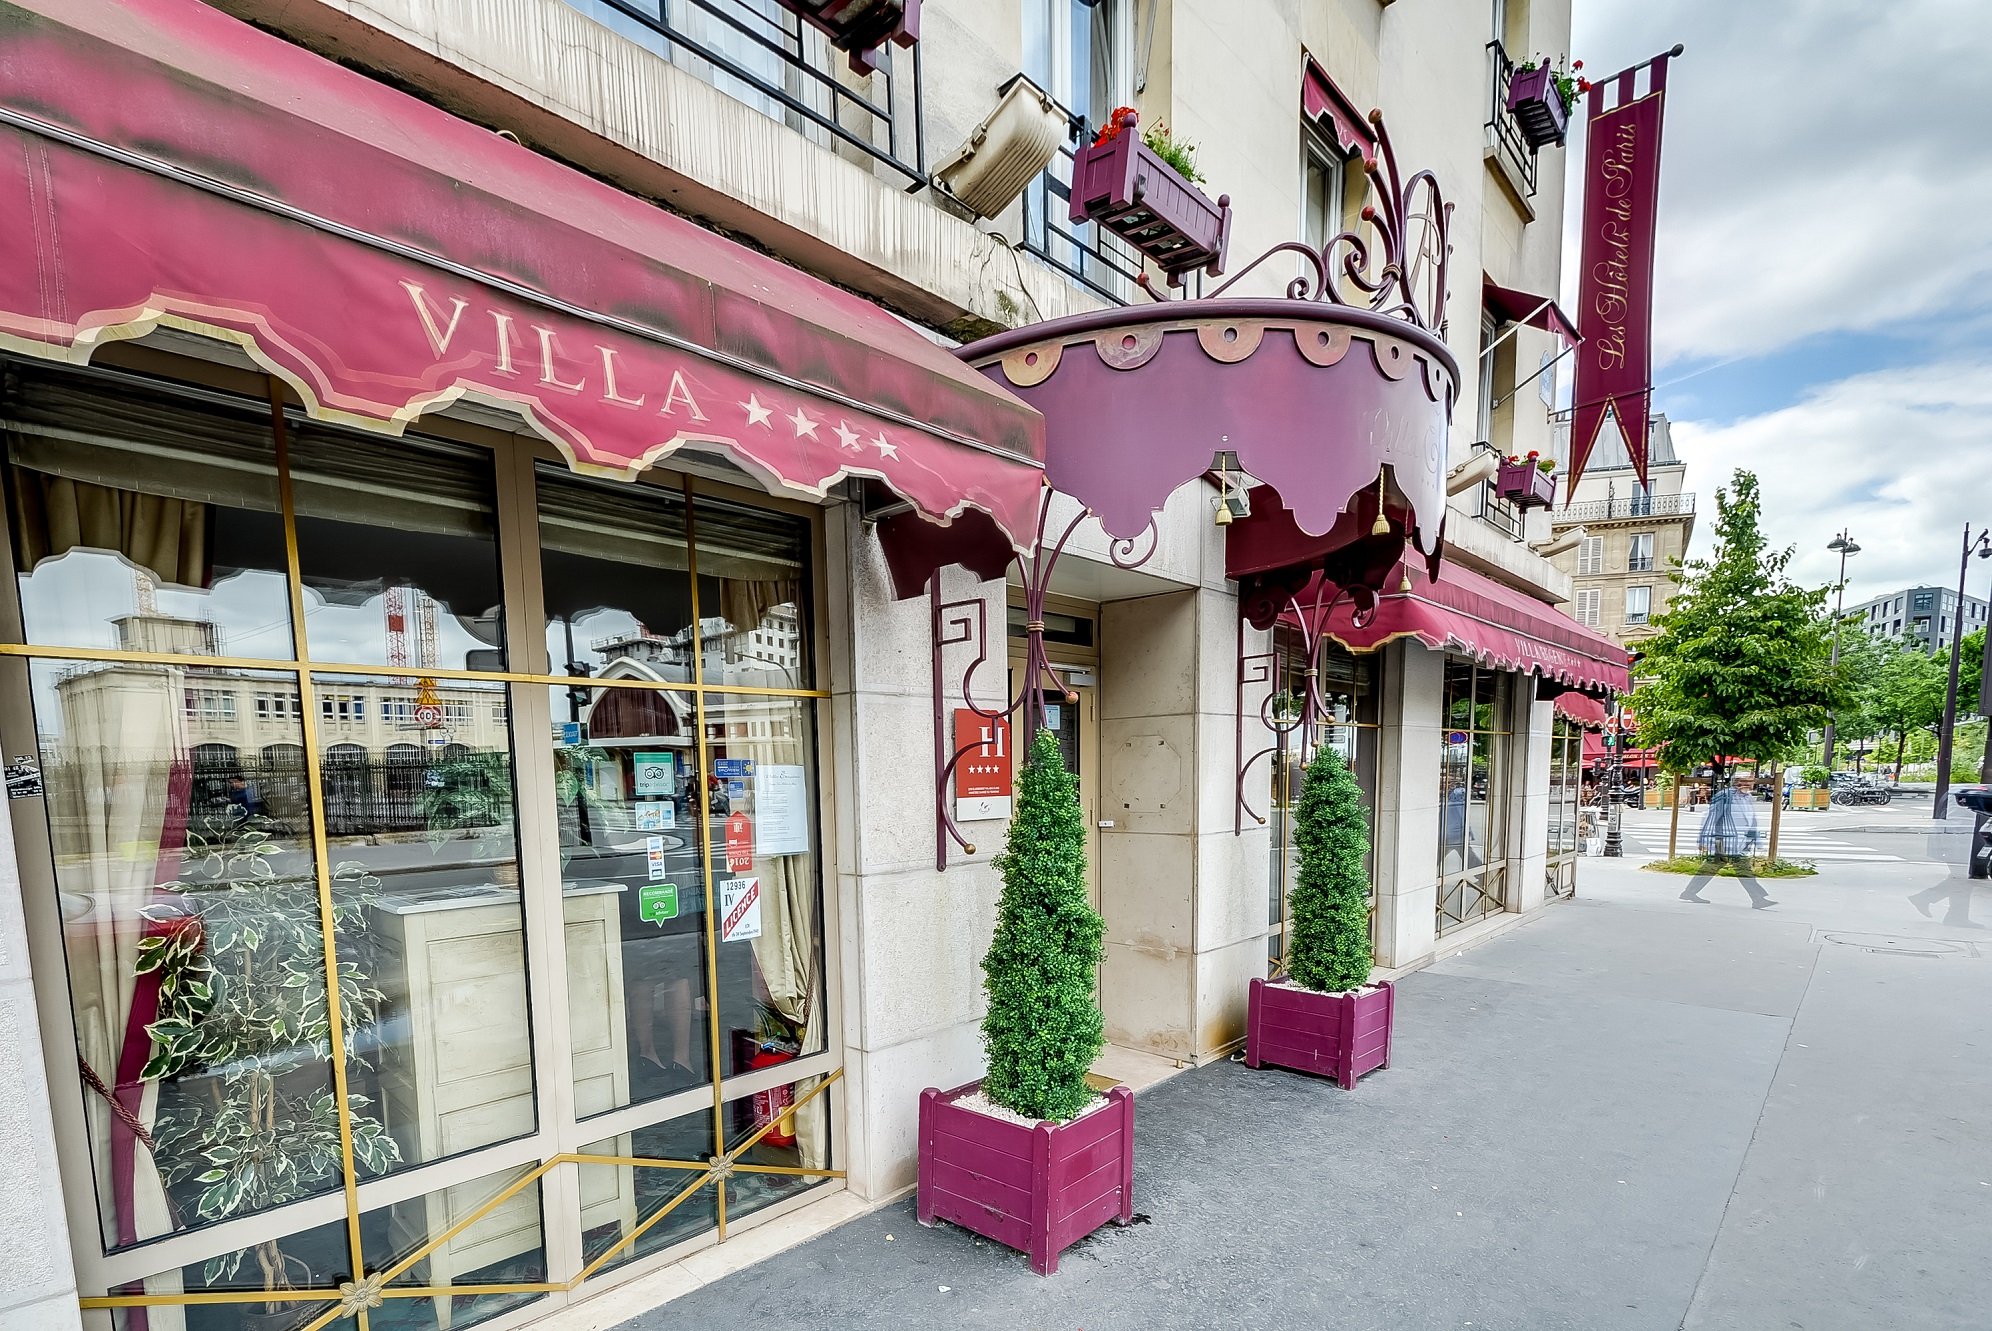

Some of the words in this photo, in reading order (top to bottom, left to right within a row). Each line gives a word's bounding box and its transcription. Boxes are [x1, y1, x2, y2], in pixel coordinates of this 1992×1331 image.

[1601, 123, 1637, 198] Paris
[1605, 198, 1632, 221] de
[1593, 221, 1631, 324] Hôtels
[399, 279, 711, 423] VILLA
[1596, 326, 1626, 370] Les
[1514, 638, 1541, 660] VILLA
[979, 726, 1005, 758] H
[724, 893, 734, 907] IV
[726, 880, 746, 891] 12936
[725, 886, 756, 934] LICENCE
